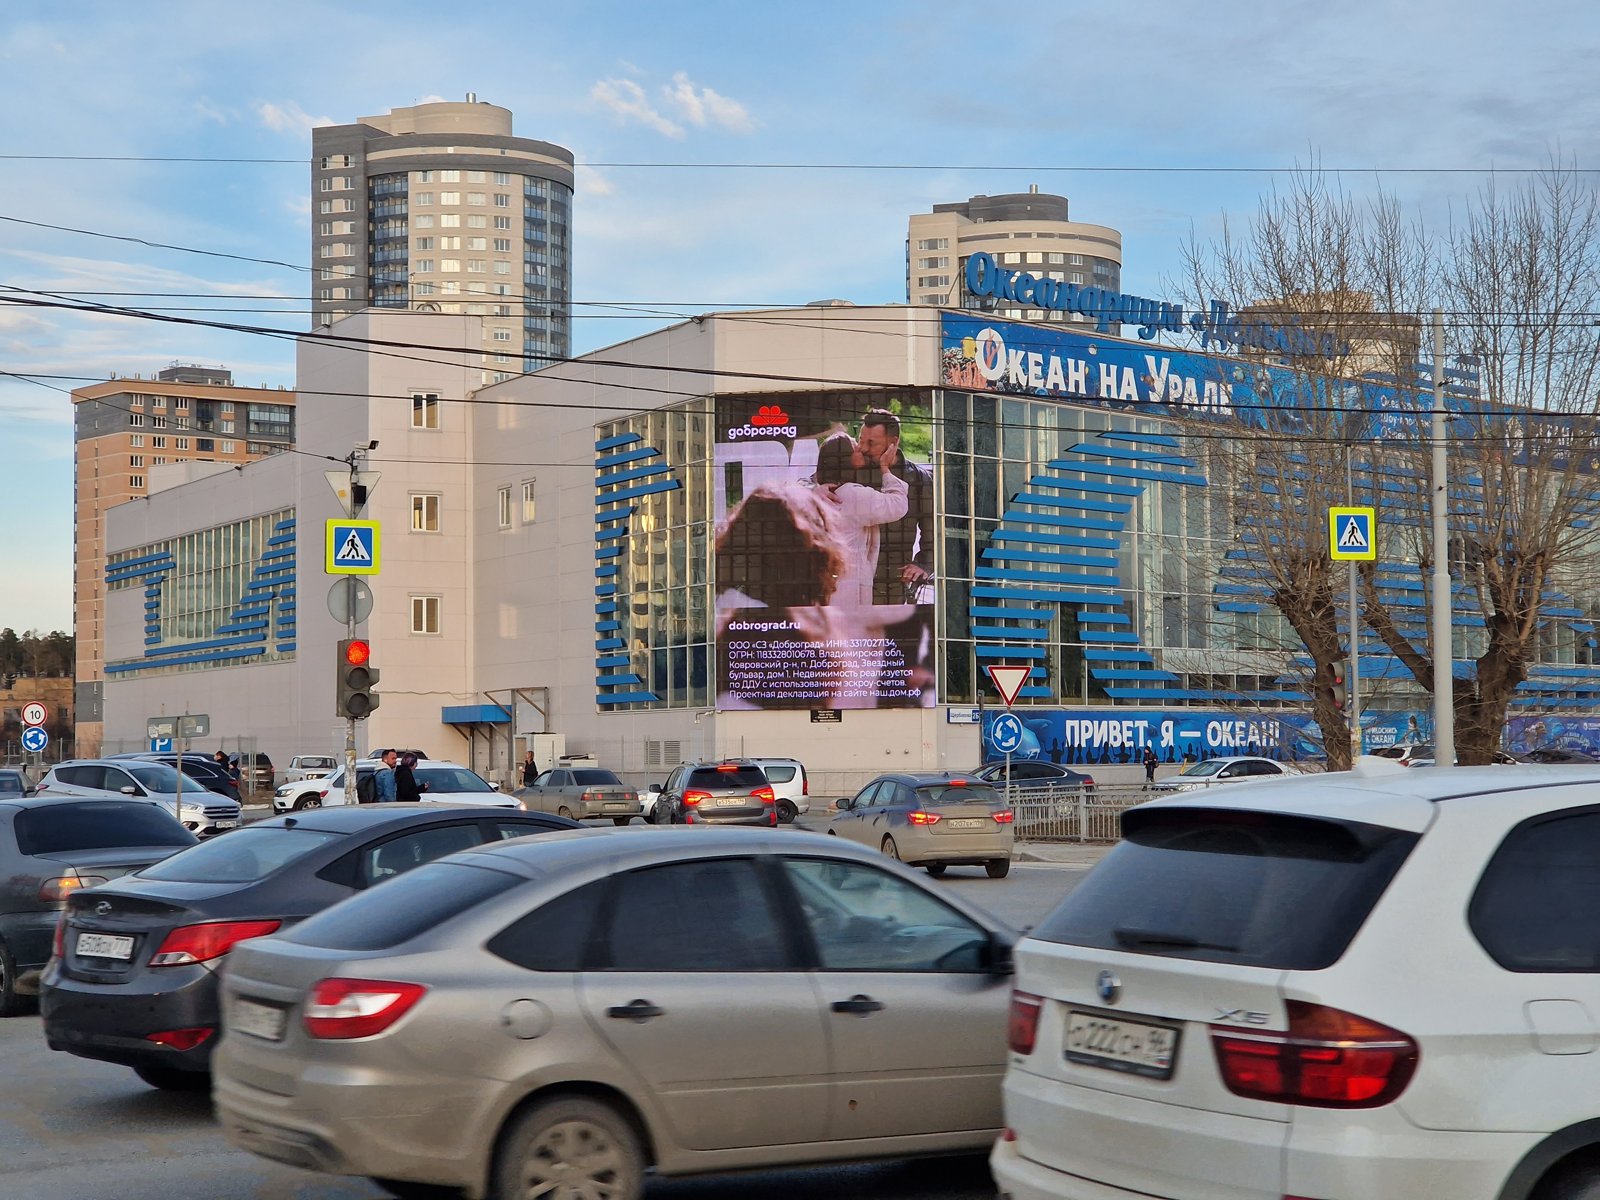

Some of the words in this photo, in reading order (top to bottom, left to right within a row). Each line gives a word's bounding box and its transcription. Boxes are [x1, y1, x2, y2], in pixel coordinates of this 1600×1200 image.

[966, 251, 1184, 340] Океанариум
[728, 424, 797, 440] доброград
[728, 620, 801, 632] dobrograd.ru
[729, 641, 750, 650] ООО
[769, 639, 824, 650] «Доброград»
[826, 639, 849, 648] ИНН:
[729, 651, 755, 659] ОГРН:
[819, 649, 883, 659] Владимирская
[729, 660, 781, 669] Ковровский
[809, 659, 859, 669] Доброград,
[861, 658, 905, 668] Звездный
[729, 671, 766, 680] бульвар,
[767, 672, 784, 680] дом
[793, 670, 858, 679] Недвижимость
[860, 669, 913, 679] реализуется
[729, 681, 740, 689] по
[741, 680, 761, 690] ДДУ
[769, 679, 842, 689] использованием
[844, 679, 906, 689] эскроу-счетов.
[729, 690, 776, 699] Проектная
[777, 690, 830, 699] декларация
[831, 690, 842, 698] на
[846, 688, 867, 698] сайте
[869, 688, 922, 699] наш.дом.рф
[30, 710, 41, 720] 10
[1065, 719, 1153, 748] ПРИВЕТ,
[1161, 720, 1174, 747] Я
